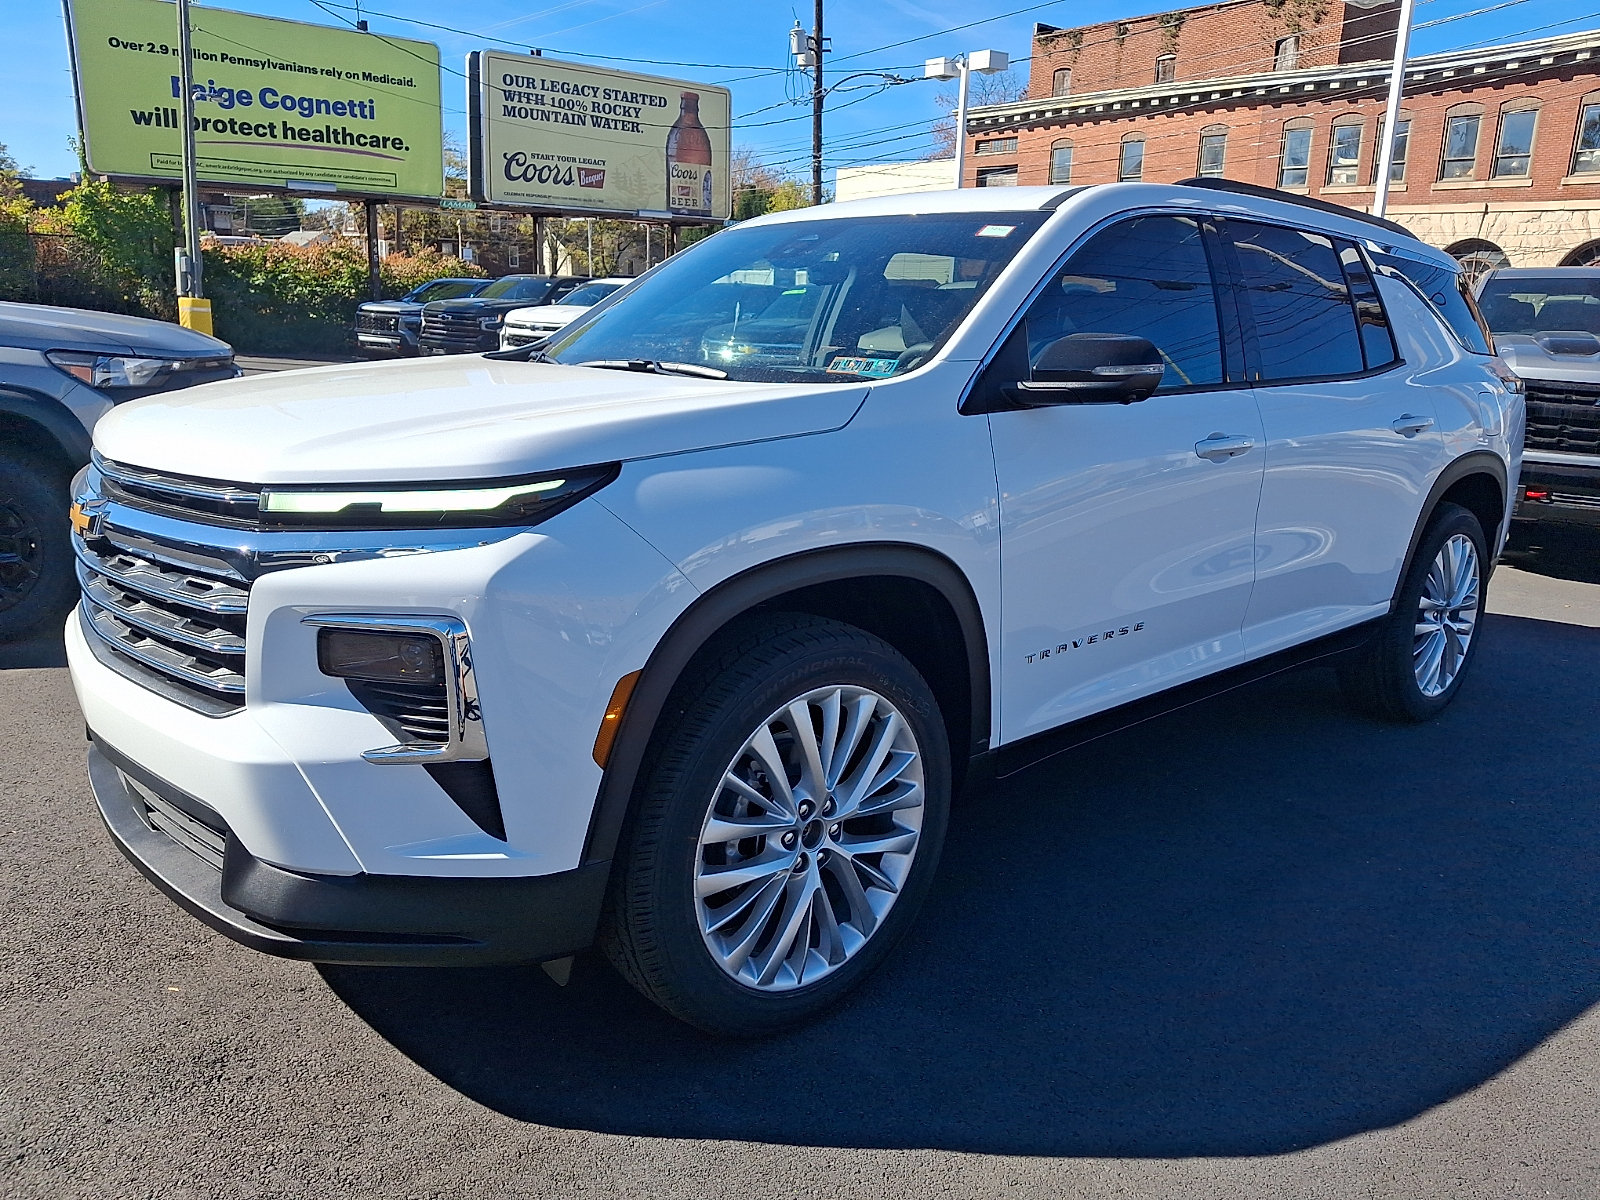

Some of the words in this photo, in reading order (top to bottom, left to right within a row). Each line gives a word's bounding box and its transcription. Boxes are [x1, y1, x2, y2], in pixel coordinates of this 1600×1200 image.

[108, 37, 144, 51] Over
[147, 42, 169, 55] 2.9
[172, 48, 217, 62] mlion
[220, 52, 319, 75] Pennsylvanians
[320, 67, 343, 80] rely
[345, 70, 360, 80] on
[362, 71, 417, 88] Medicaid.
[258, 88, 375, 120] Cognetti
[502, 73, 537, 89] OUR
[540, 78, 600, 98] LEGACY
[603, 88, 668, 108] STARTED
[503, 89, 546, 106] WITH
[550, 96, 588, 112] 100%
[591, 101, 642, 119] ROCKY
[130, 107, 179, 129] will
[281, 120, 410, 152] healthcare.
[502, 104, 586, 126] MOUNTAIN
[590, 115, 644, 133] WATER.
[156, 158, 168, 166] Paid
[196, 161, 205, 169] AC,
[273, 168, 298, 176] authorized
[503, 151, 575, 186] Coors
[530, 152, 555, 161] START
[556, 155, 577, 163] YOUR
[579, 157, 606, 166] LEGACY
[671, 164, 698, 180] Coors
[580, 170, 603, 185] Banquet
[443, 200, 472, 209] LAMAR
[671, 196, 698, 208] BEER
[1025, 621, 1145, 664] TRAVERSE
